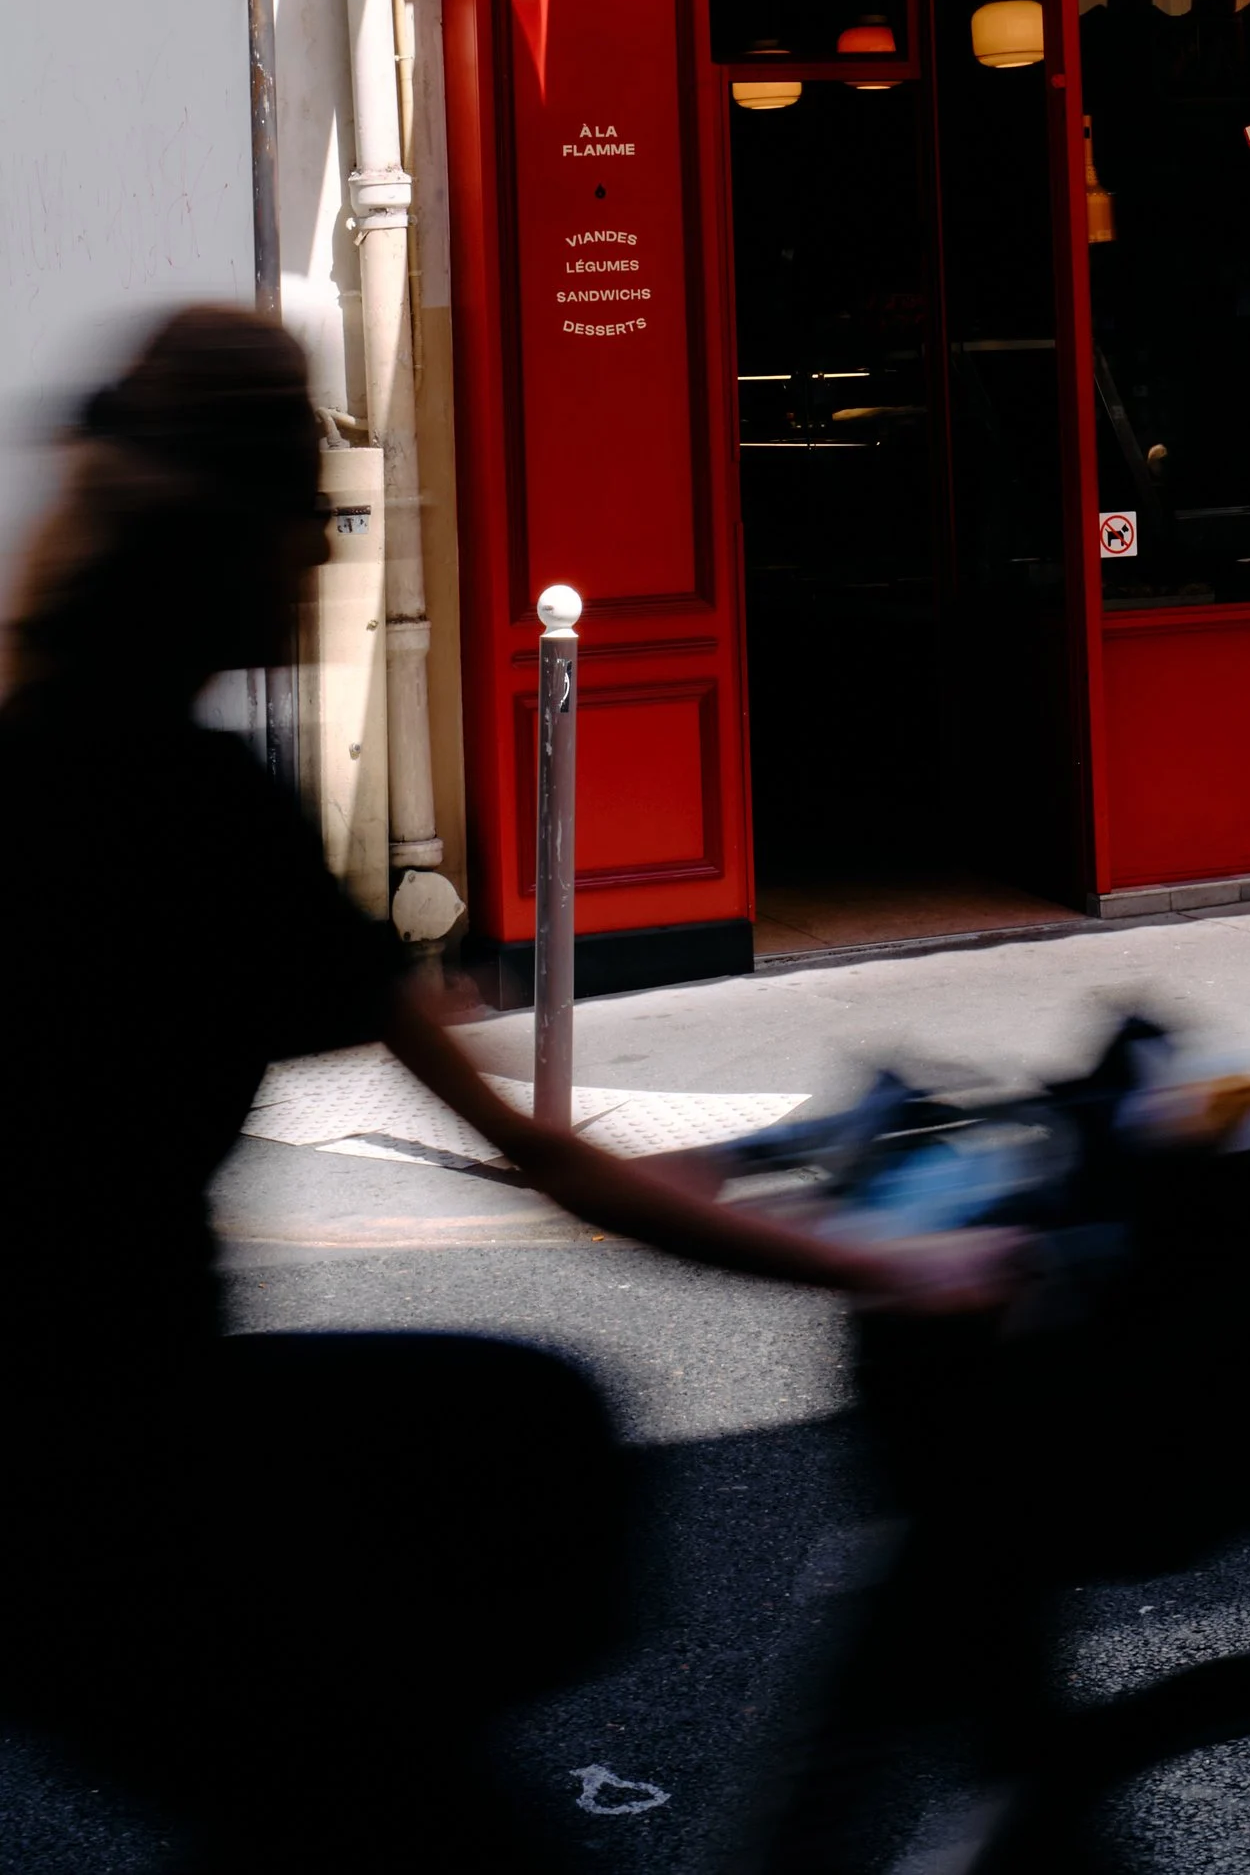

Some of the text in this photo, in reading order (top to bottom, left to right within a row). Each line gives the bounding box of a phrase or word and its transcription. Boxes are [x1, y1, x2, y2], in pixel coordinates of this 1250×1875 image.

[579, 123, 618, 138] À LA
[562, 143, 636, 157] FLAMME
[565, 230, 638, 247] VIANDES
[566, 259, 640, 274] LÉGUMES
[556, 288, 652, 303] SANDWICHS
[562, 317, 647, 336] DESSERTS
